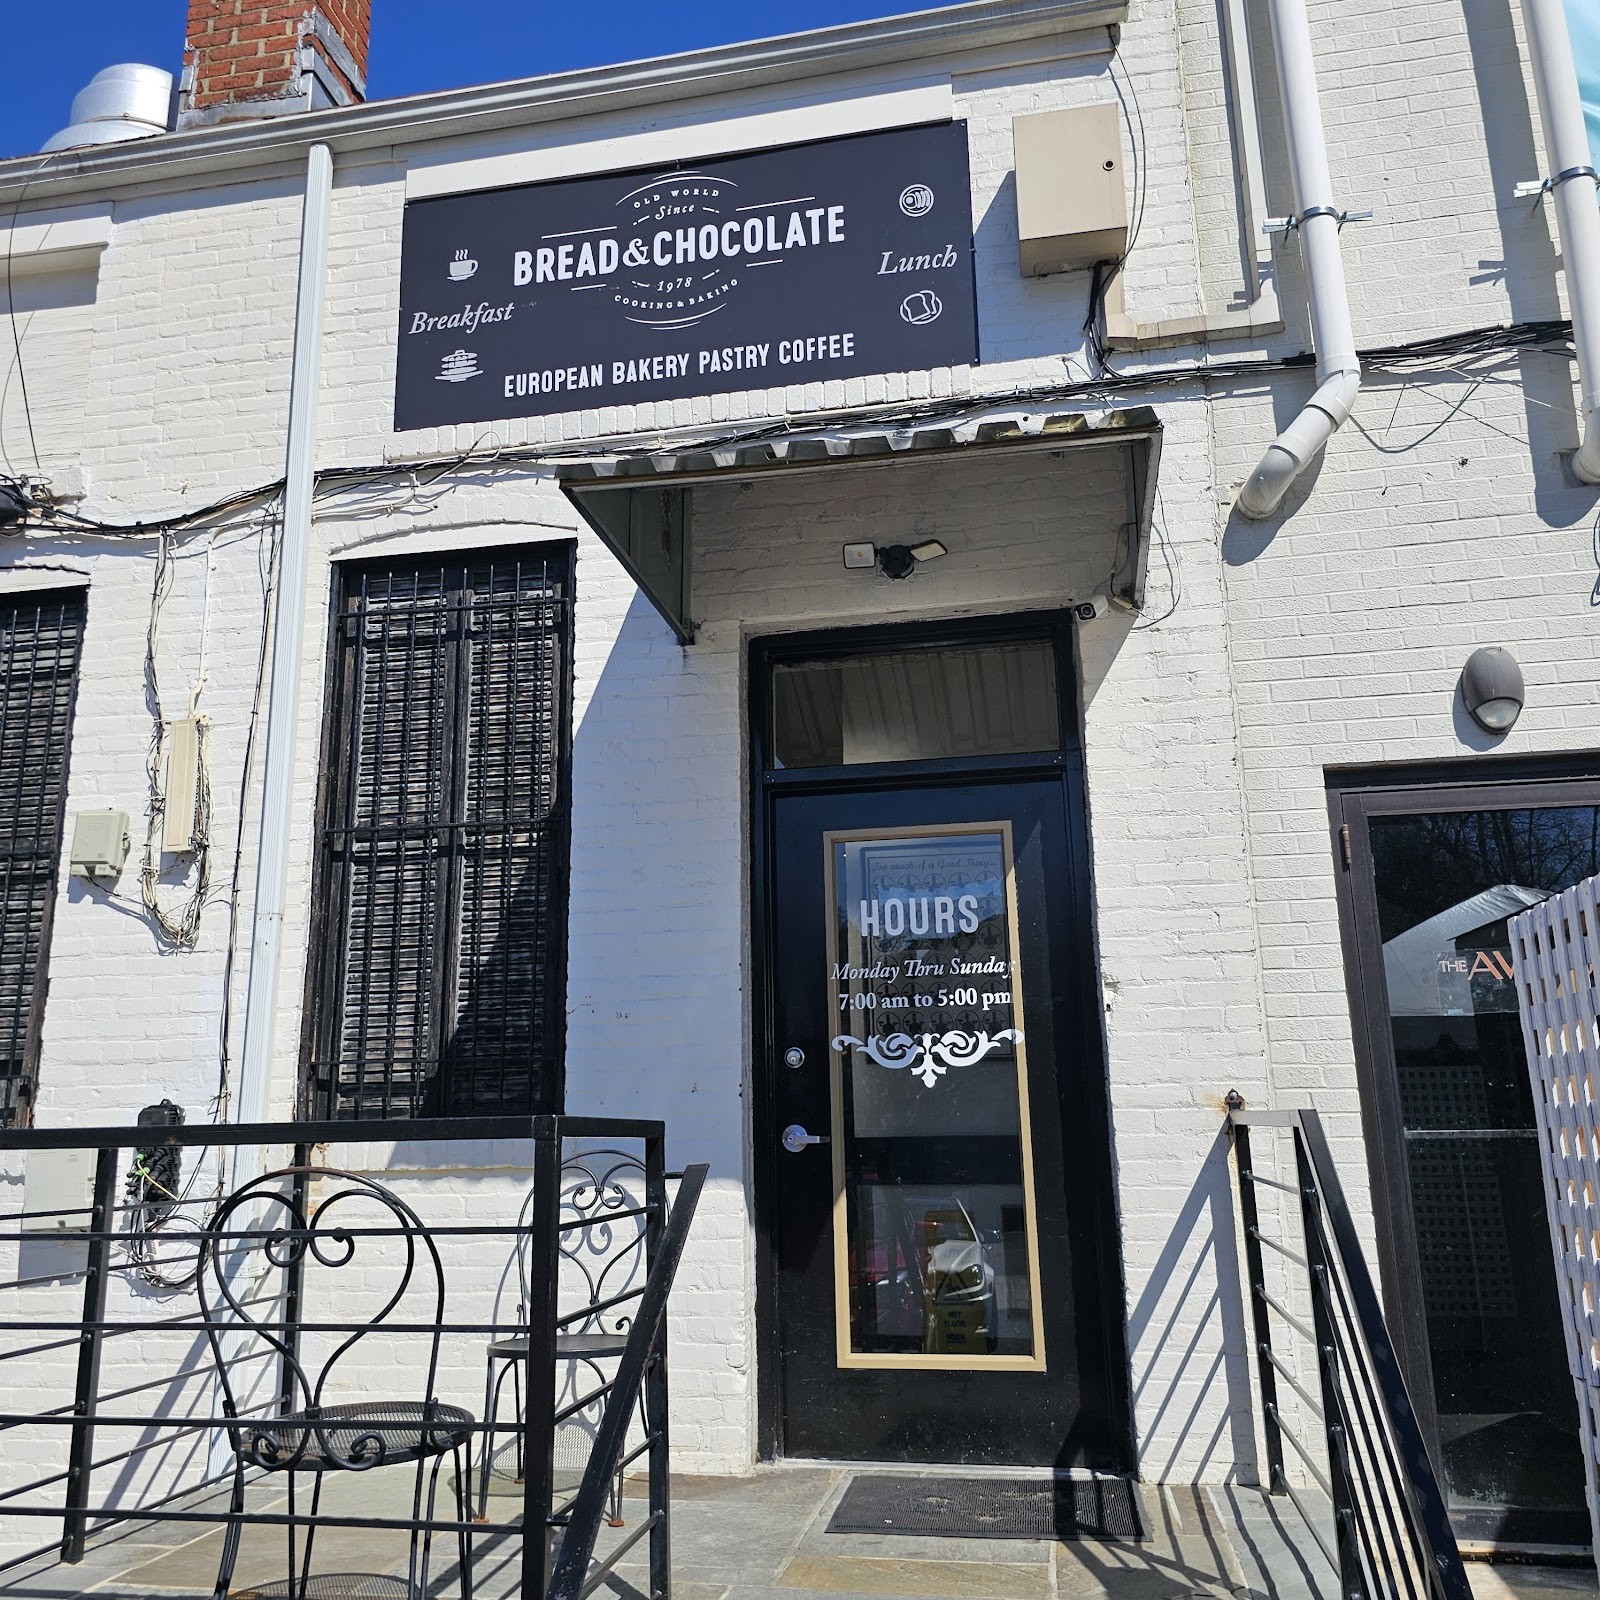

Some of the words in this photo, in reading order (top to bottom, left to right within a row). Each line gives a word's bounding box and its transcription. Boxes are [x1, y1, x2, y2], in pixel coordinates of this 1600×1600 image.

[633, 194, 661, 209] OLD
[670, 188, 720, 198] WORLD
[654, 204, 695, 220] Since
[877, 244, 958, 276] Lunch
[656, 276, 693, 293] 1978
[409, 300, 515, 336] Breakfast
[504, 363, 603, 398] EUROPEAN
[611, 353, 690, 385] BAKERY
[698, 343, 770, 375] PASTRY
[778, 332, 855, 365] COFFEE
[860, 894, 979, 937] HOURS
[831, 962, 900, 984] Monday
[903, 959, 945, 978] Thru
[949, 956, 1016, 979] Sunday
[1438, 959, 1468, 973] THE
[838, 992, 877, 1011] 7:00
[881, 996, 910, 1009] am
[913, 993, 933, 1008] to
[937, 987, 978, 1007] 5:00
[981, 991, 1012, 1011] pm
